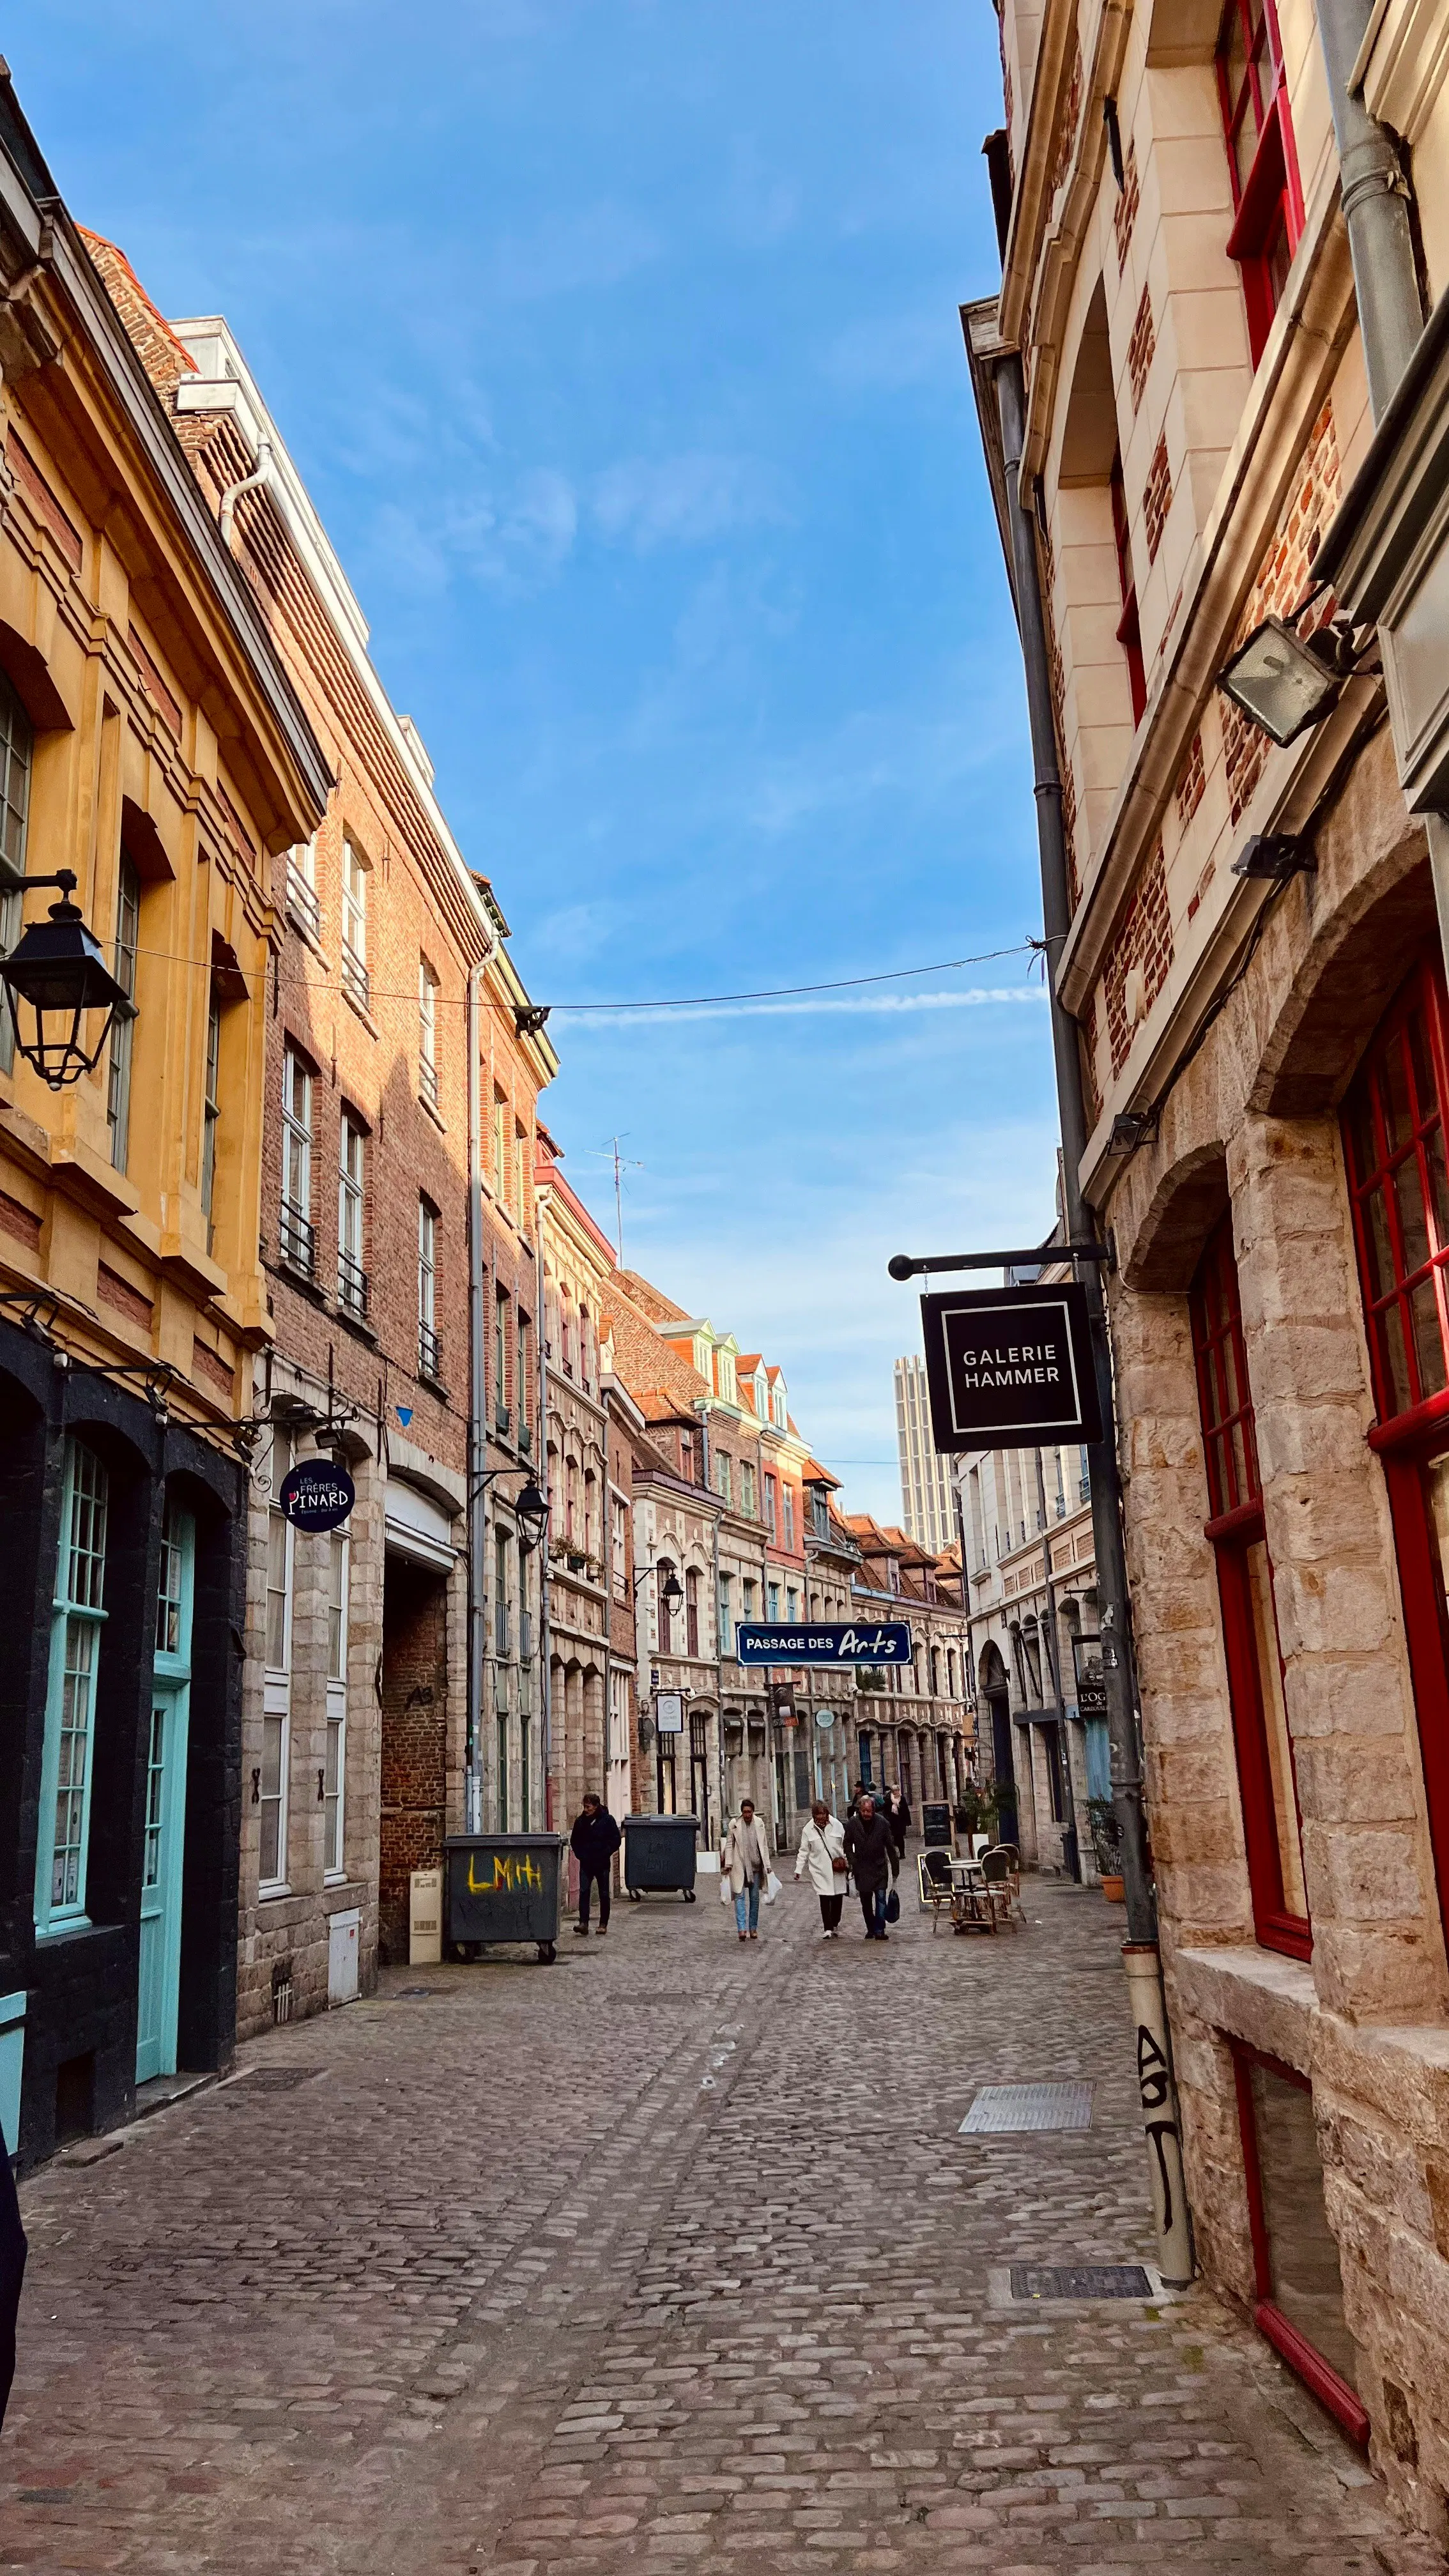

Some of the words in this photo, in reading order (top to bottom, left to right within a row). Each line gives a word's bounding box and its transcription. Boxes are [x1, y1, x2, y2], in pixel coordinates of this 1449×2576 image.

[963, 1344, 1056, 1366] GALERIE
[965, 1367, 1060, 1388] HAMMER
[746, 1637, 805, 1649] PASSAGE
[808, 1637, 833, 1649] DES
[838, 1629, 897, 1656] Arts
[1080, 1692, 1106, 1702] L'OG
